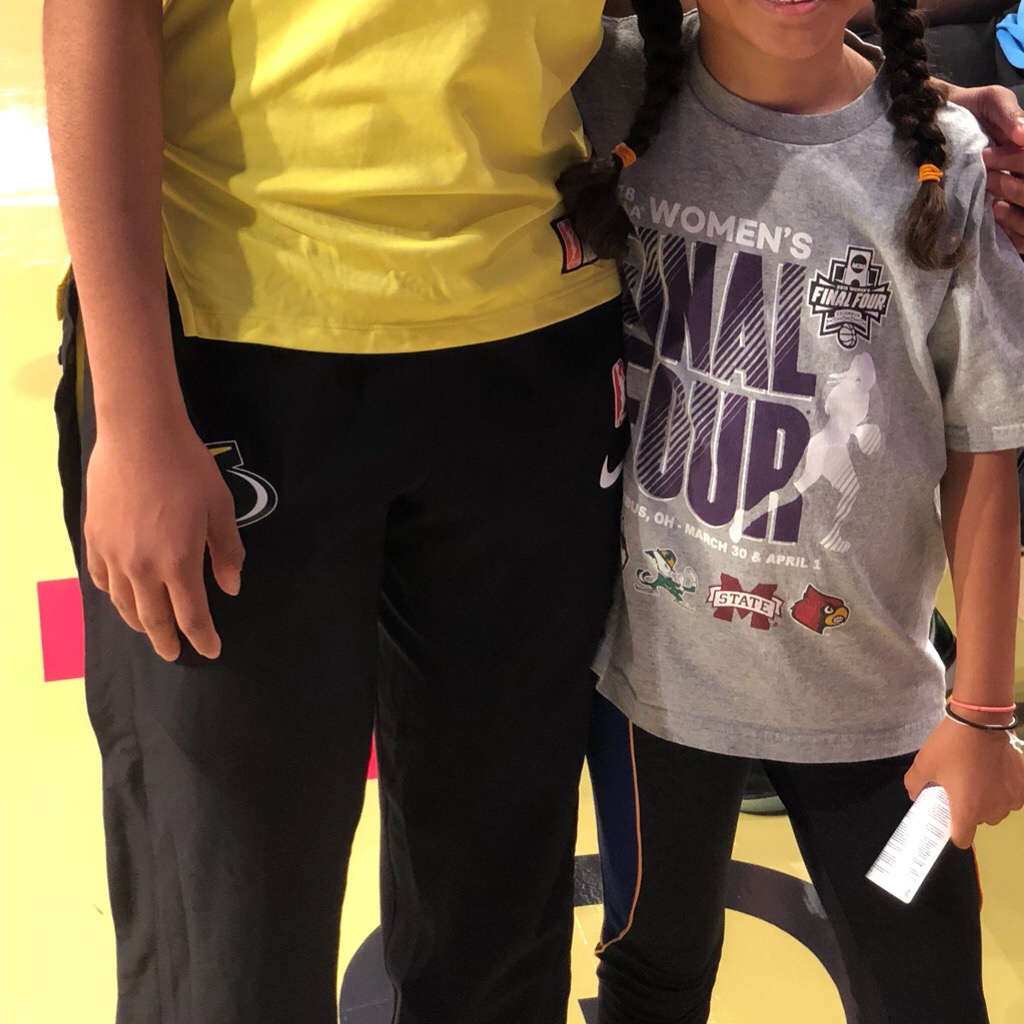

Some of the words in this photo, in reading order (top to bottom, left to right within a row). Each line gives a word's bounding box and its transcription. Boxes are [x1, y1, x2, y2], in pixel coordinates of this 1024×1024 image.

[649, 196, 813, 260] WOMEN'S
[811, 285, 852, 307] FINAL
[654, 511, 676, 529] OH
[684, 523, 729, 554] MARCH
[731, 546, 748, 560] 30
[751, 551, 762, 564] &
[766, 555, 808, 569] APRIL
[813, 558, 822, 571] 1
[718, 593, 771, 615] STATE
